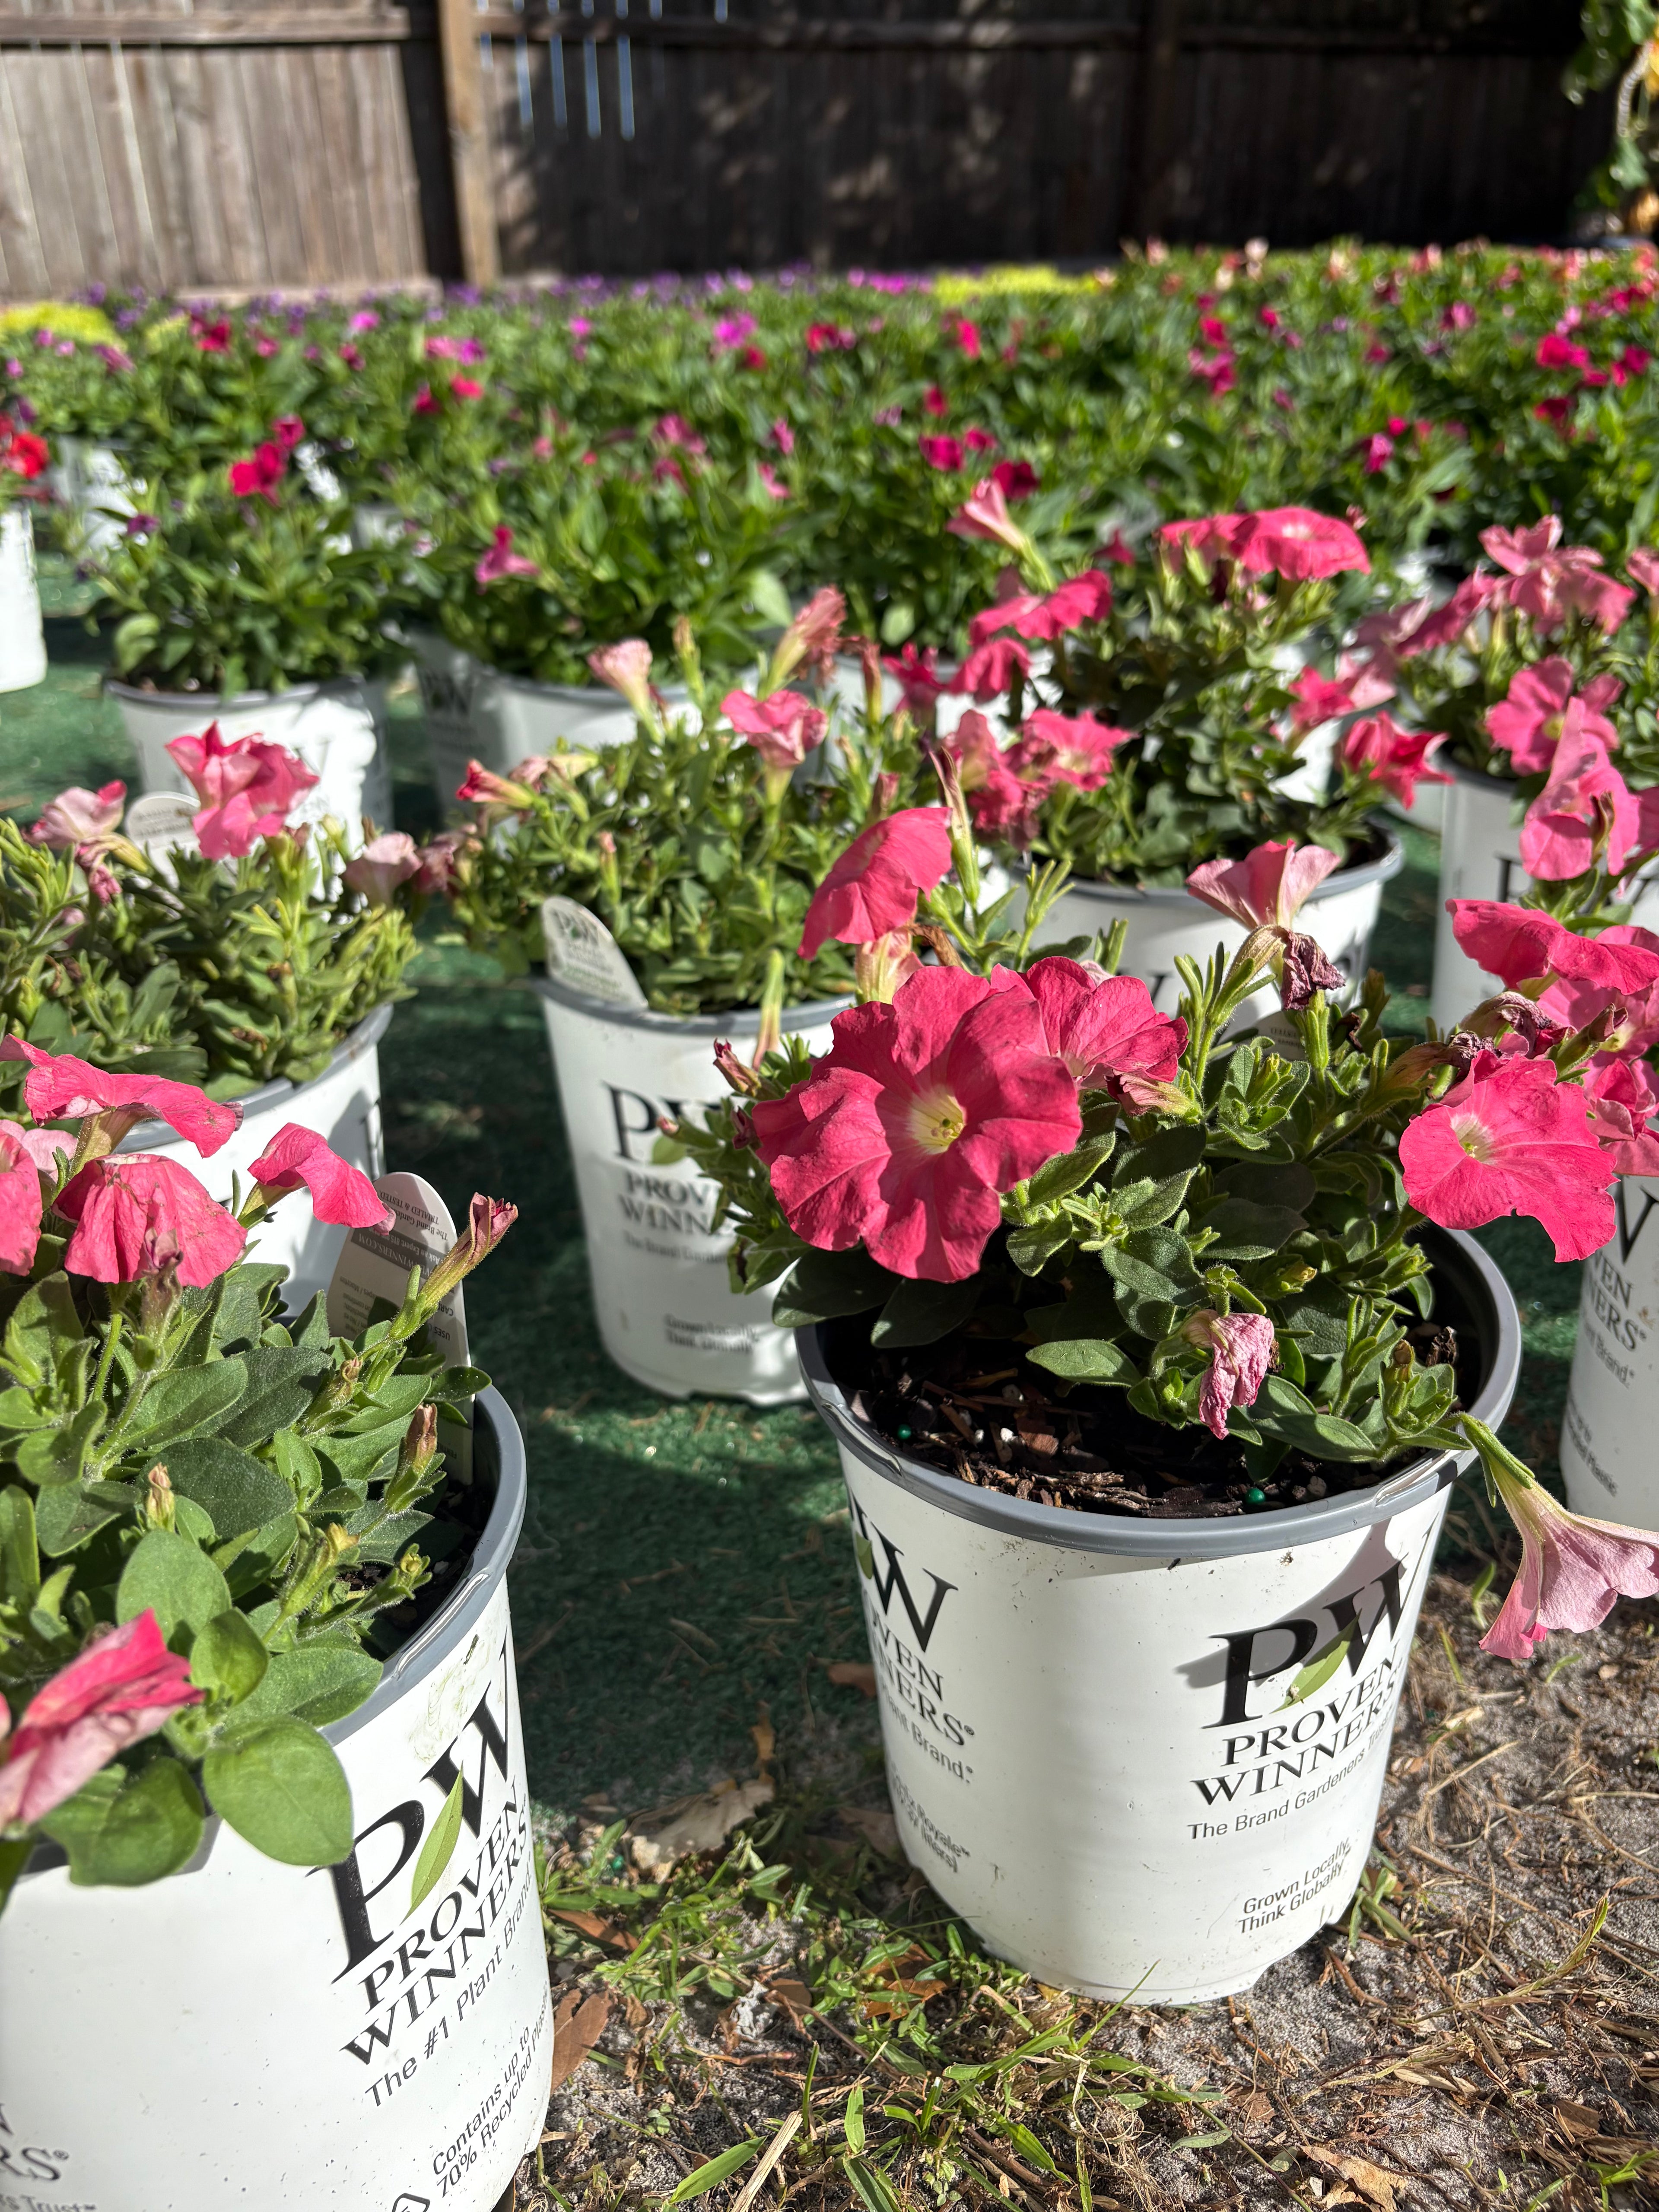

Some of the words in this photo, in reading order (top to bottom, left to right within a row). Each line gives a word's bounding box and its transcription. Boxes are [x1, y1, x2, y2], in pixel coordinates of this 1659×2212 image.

[394, 1210, 415, 1226] Garde
[416, 1220, 435, 1236] Brand
[619, 1193, 713, 1236] WINN
[624, 1168, 710, 1205] PROV
[429, 1252, 440, 1262] Ask
[436, 1228, 448, 1241] The
[434, 1326, 451, 1341] USES
[866, 1594, 944, 1701] VEN
[1201, 1511, 1439, 1729] PW
[1220, 1638, 1400, 1767] PROVEN
[306, 1624, 510, 1986] PW
[1187, 1821, 1228, 1840] The
[1235, 1799, 1289, 1831] Brand
[1295, 1748, 1366, 1809] Gardeners
[364, 1775, 518, 2015] PROVEN
[1238, 1904, 1287, 1934] Think
[1290, 1858, 1344, 1911] Globally
[1243, 1881, 1299, 1914] Grown
[365, 2056, 417, 2108] The
[423, 2015, 449, 2060] #1
[457, 1945, 502, 2021] Plant
[433, 2083, 502, 2175] Contains
[504, 2052, 518, 2084] up
[520, 2026, 529, 2052] to
[437, 2145, 477, 2198] 70%
[480, 2045, 532, 2148] Recycled
